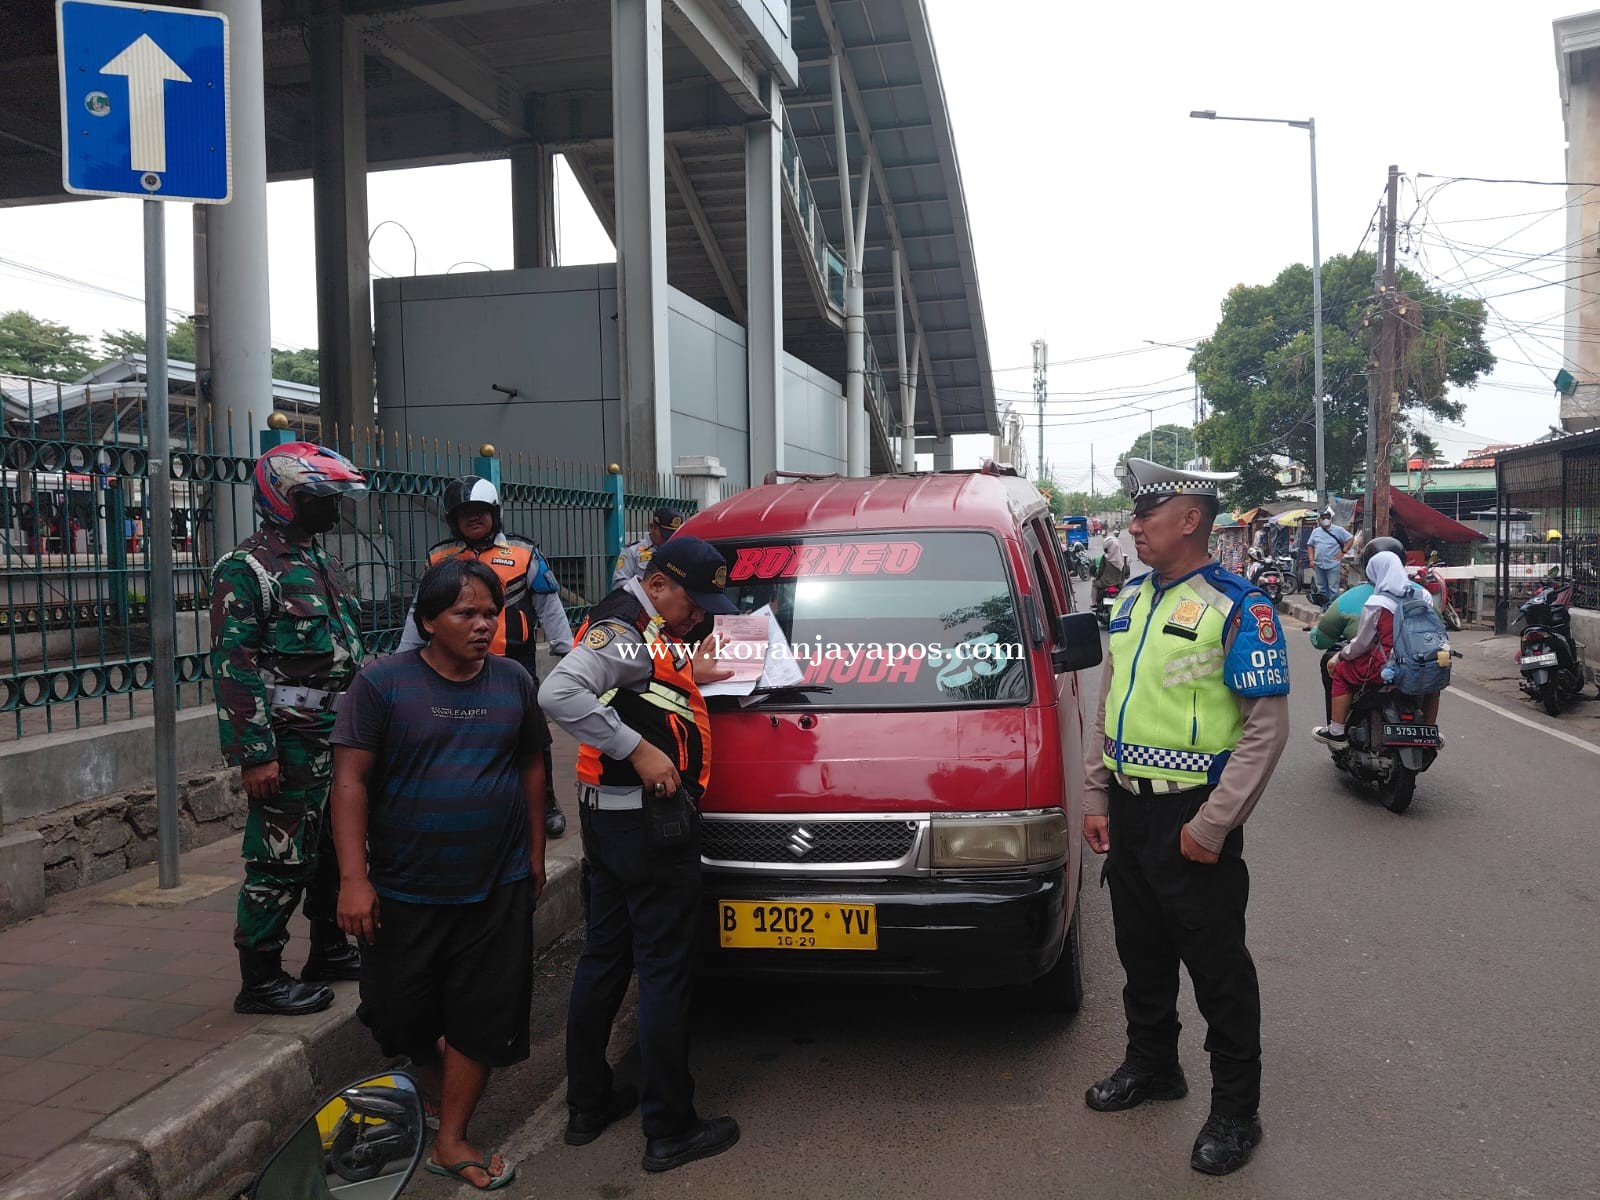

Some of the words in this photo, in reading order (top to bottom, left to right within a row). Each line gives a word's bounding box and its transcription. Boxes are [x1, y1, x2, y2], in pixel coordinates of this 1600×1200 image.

[729, 541, 924, 581] BORNEO
[792, 648, 923, 685] MUDA
[1251, 649, 1287, 669] OPS
[1233, 668, 1282, 690] LINTAS
[1386, 726, 1392, 735] B
[1396, 727, 1417, 736] 5753
[1420, 727, 1435, 736] TLC
[723, 905, 737, 932] B
[753, 906, 814, 933] 1202
